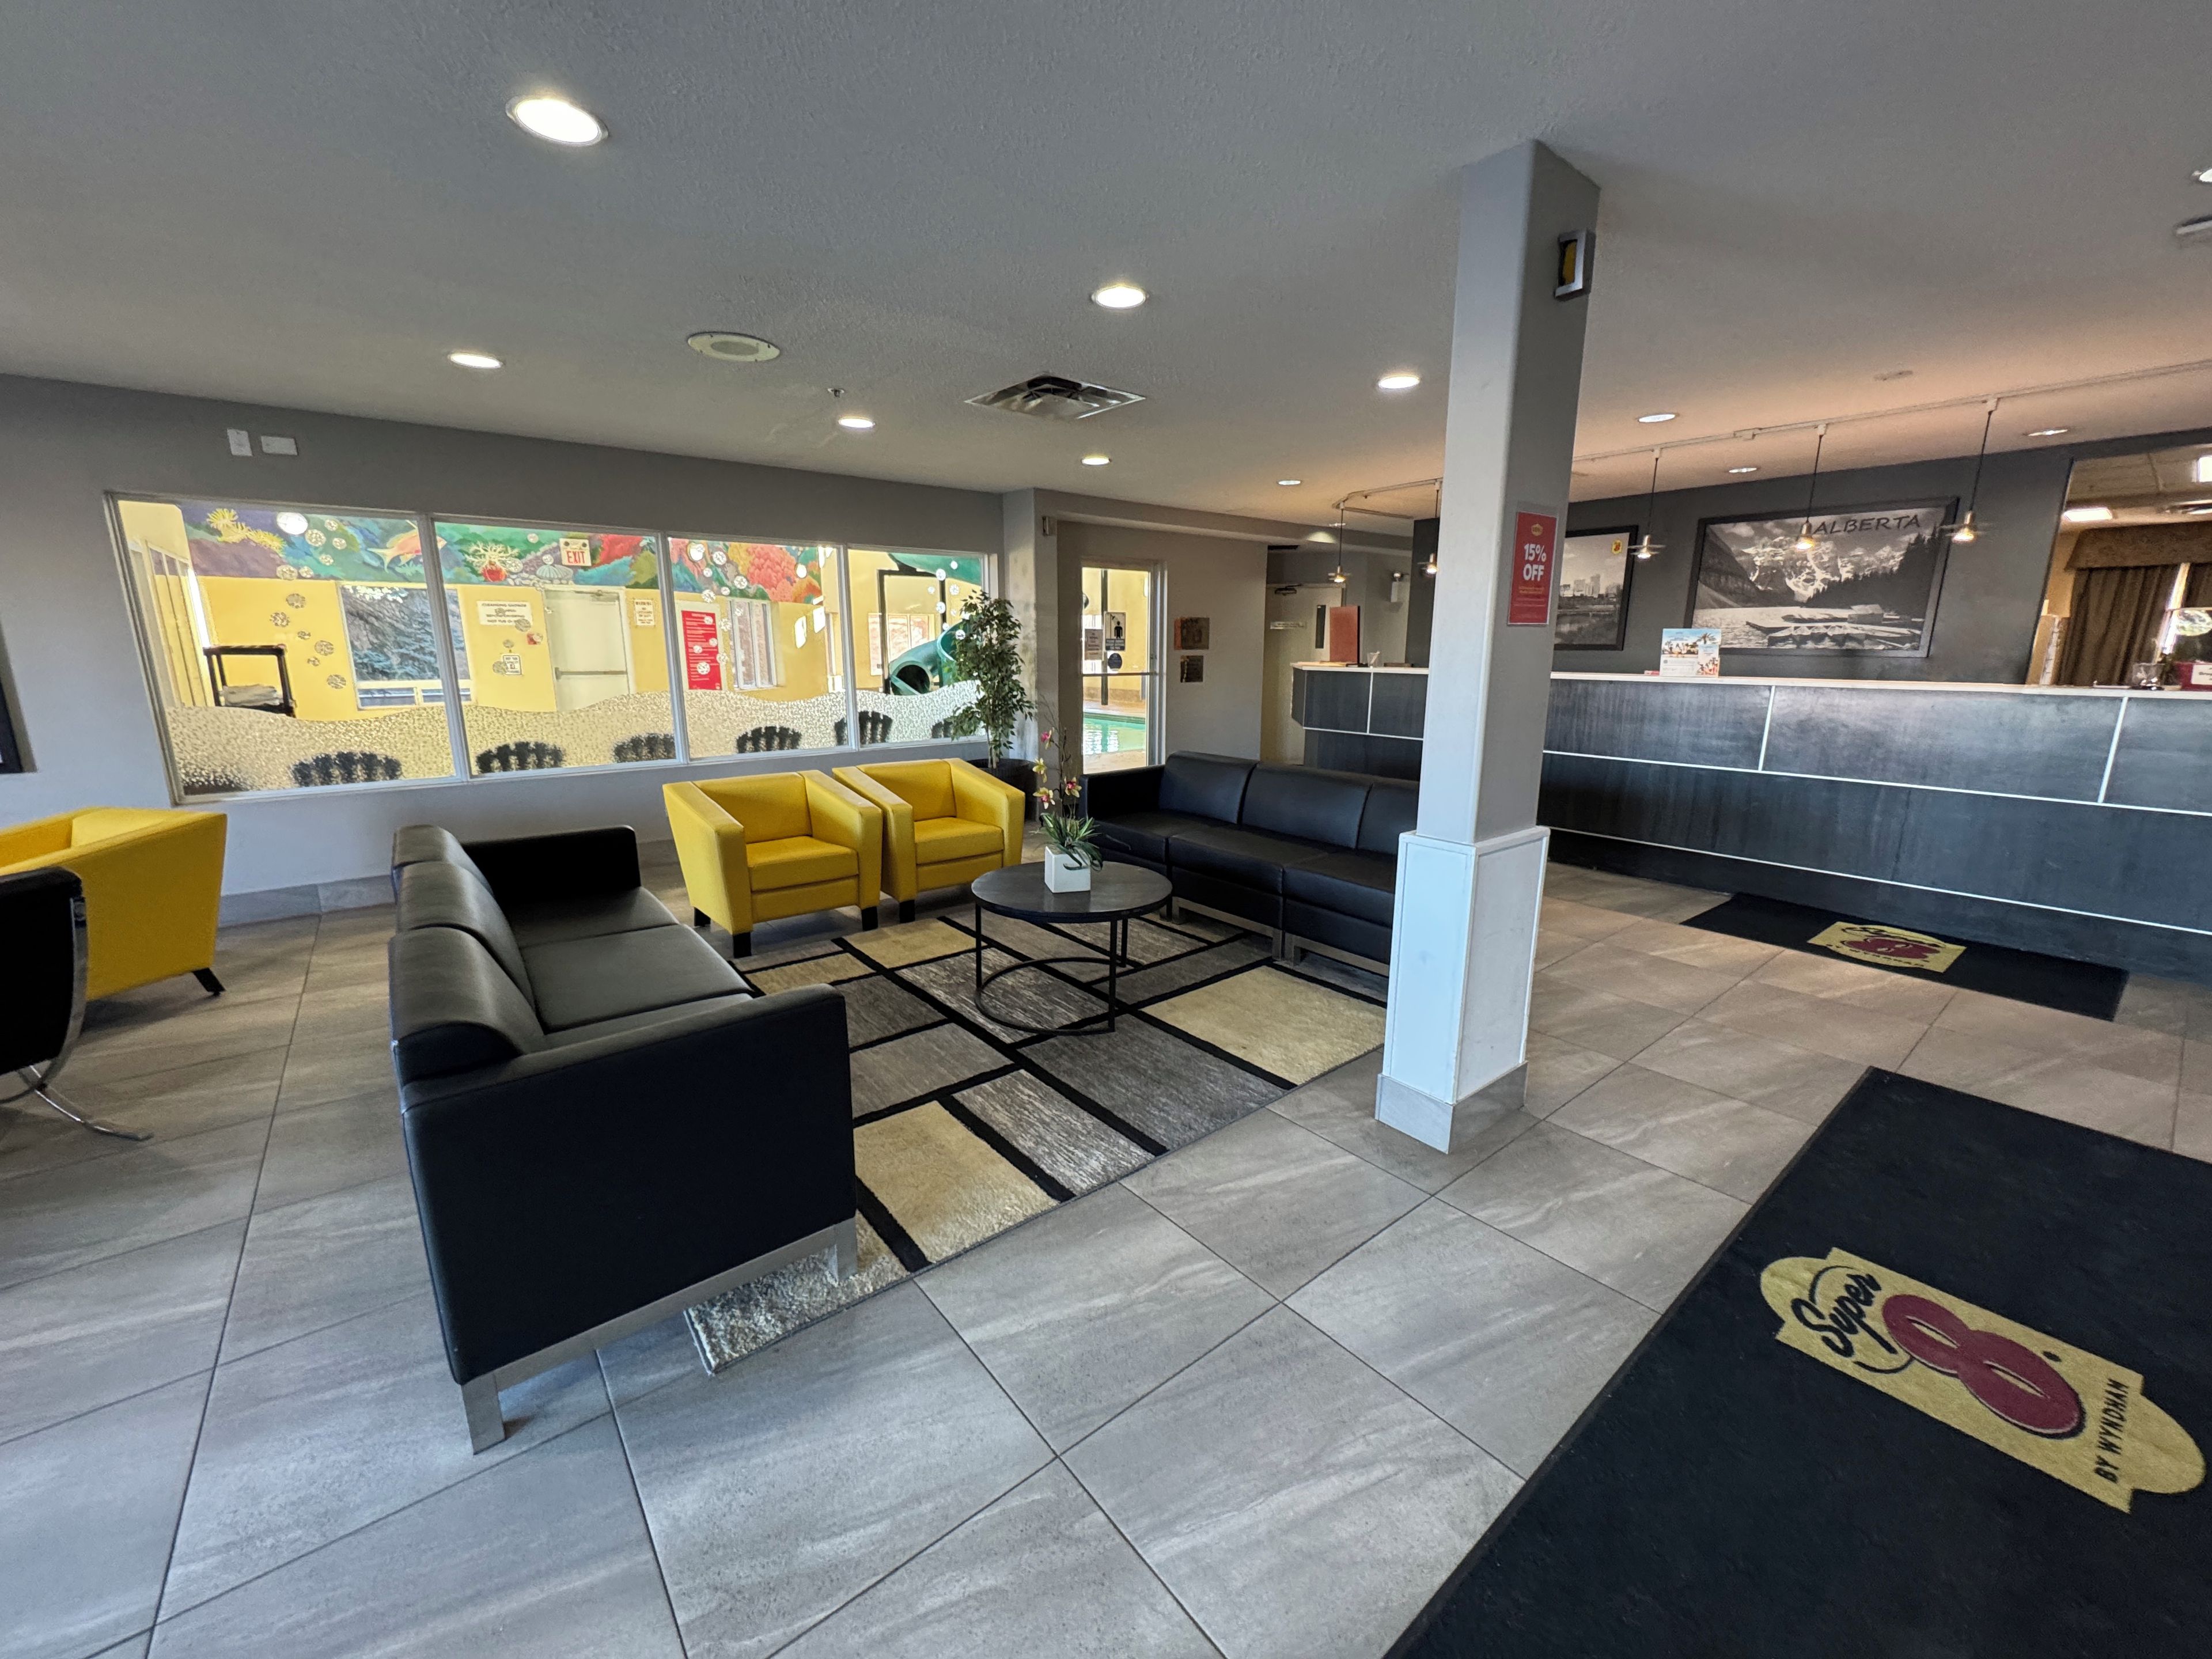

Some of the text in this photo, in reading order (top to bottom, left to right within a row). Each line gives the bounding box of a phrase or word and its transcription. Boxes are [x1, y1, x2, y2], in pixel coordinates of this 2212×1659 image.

[1813, 514, 1921, 535] ALBERTA
[566, 550, 585, 564] EXIT
[1524, 543, 1547, 562] 15%
[1523, 563, 1545, 581] OFF
[1790, 1273, 1899, 1358] Super
[1882, 1294, 2086, 1440] 8
[2094, 1378, 2130, 1484] BY WYNDHAM
